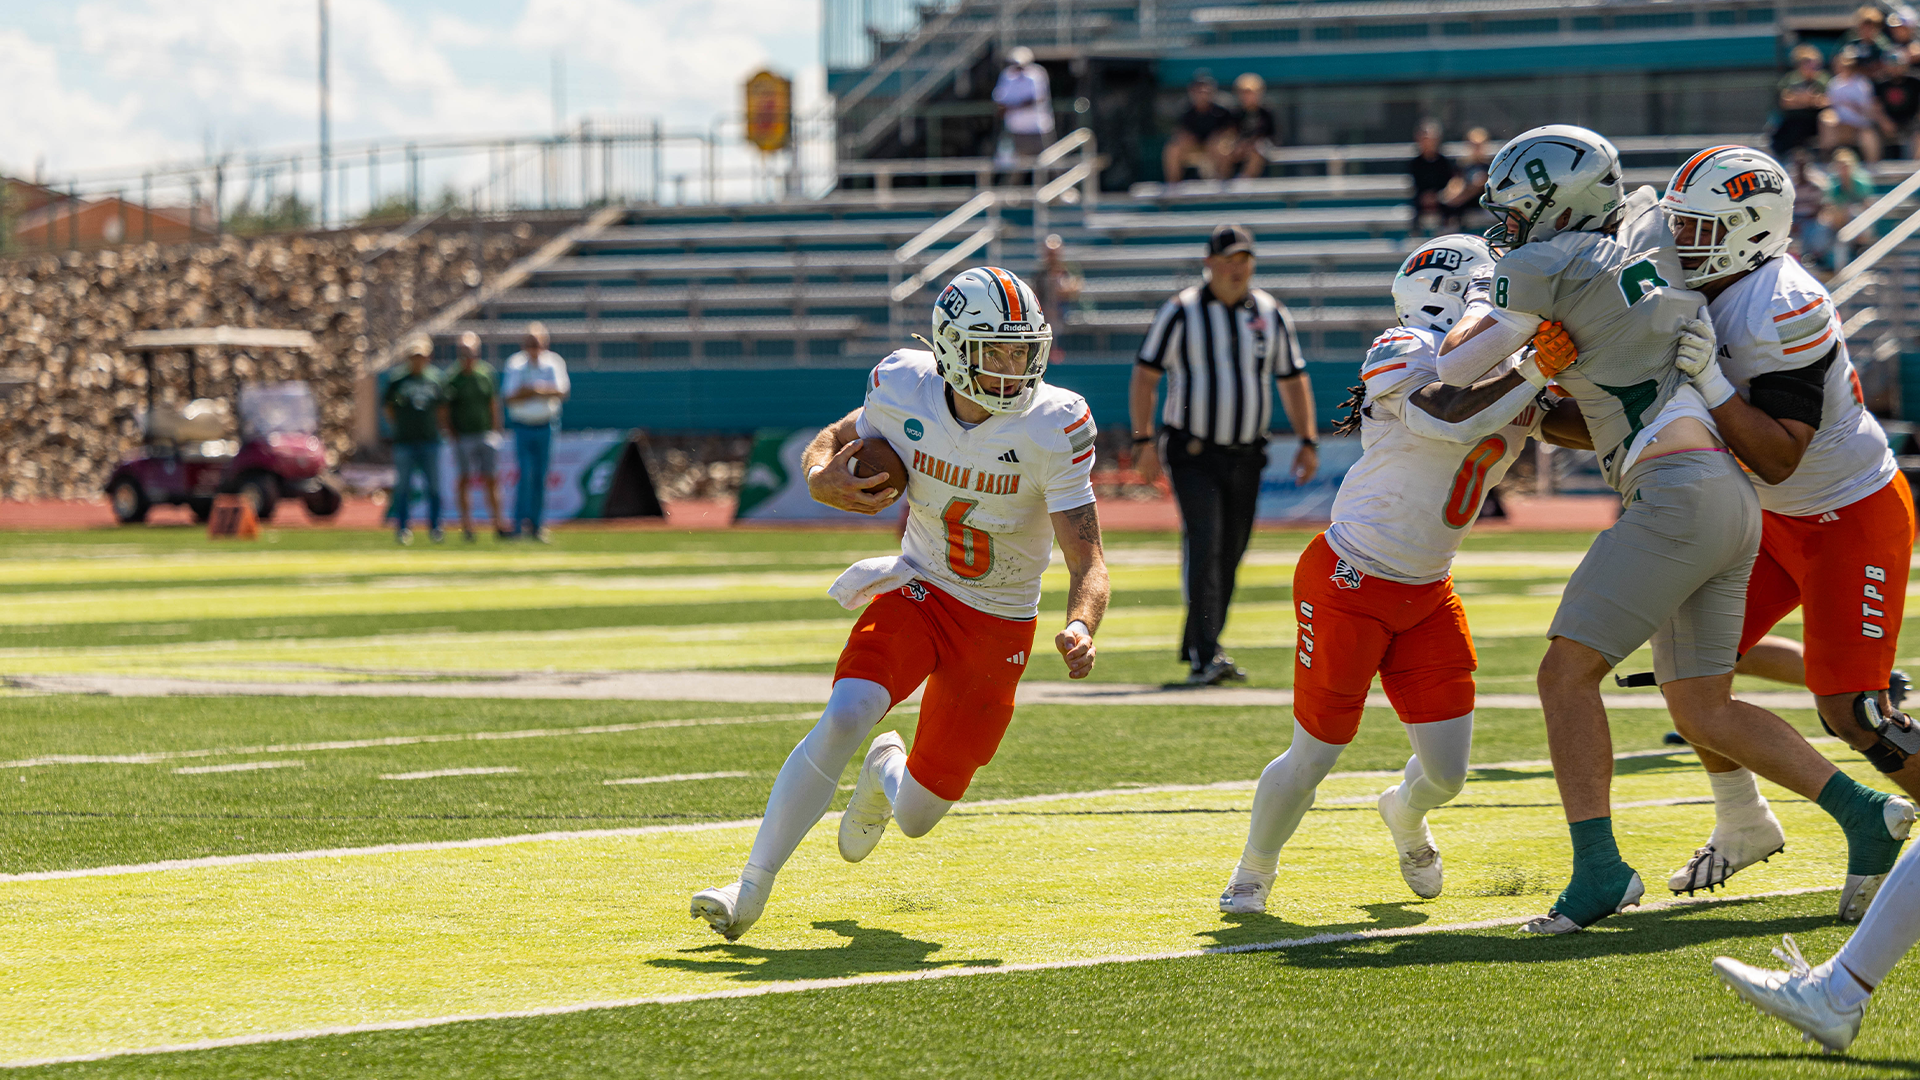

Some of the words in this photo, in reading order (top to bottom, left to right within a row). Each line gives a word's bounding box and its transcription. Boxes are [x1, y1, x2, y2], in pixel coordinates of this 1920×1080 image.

[1524, 158, 1551, 192] 8
[1725, 171, 1782, 199] UTPB
[1405, 249, 1460, 274] UTPB
[1495, 276, 1514, 309] 8
[906, 427, 922, 437] NCAA
[913, 449, 972, 489] PERMIAN
[974, 471, 1021, 495] BASIN
[1442, 433, 1508, 529] 0
[940, 496, 995, 580] 6
[1862, 564, 1886, 639] UTPB
[1299, 600, 1315, 669] UTPB
